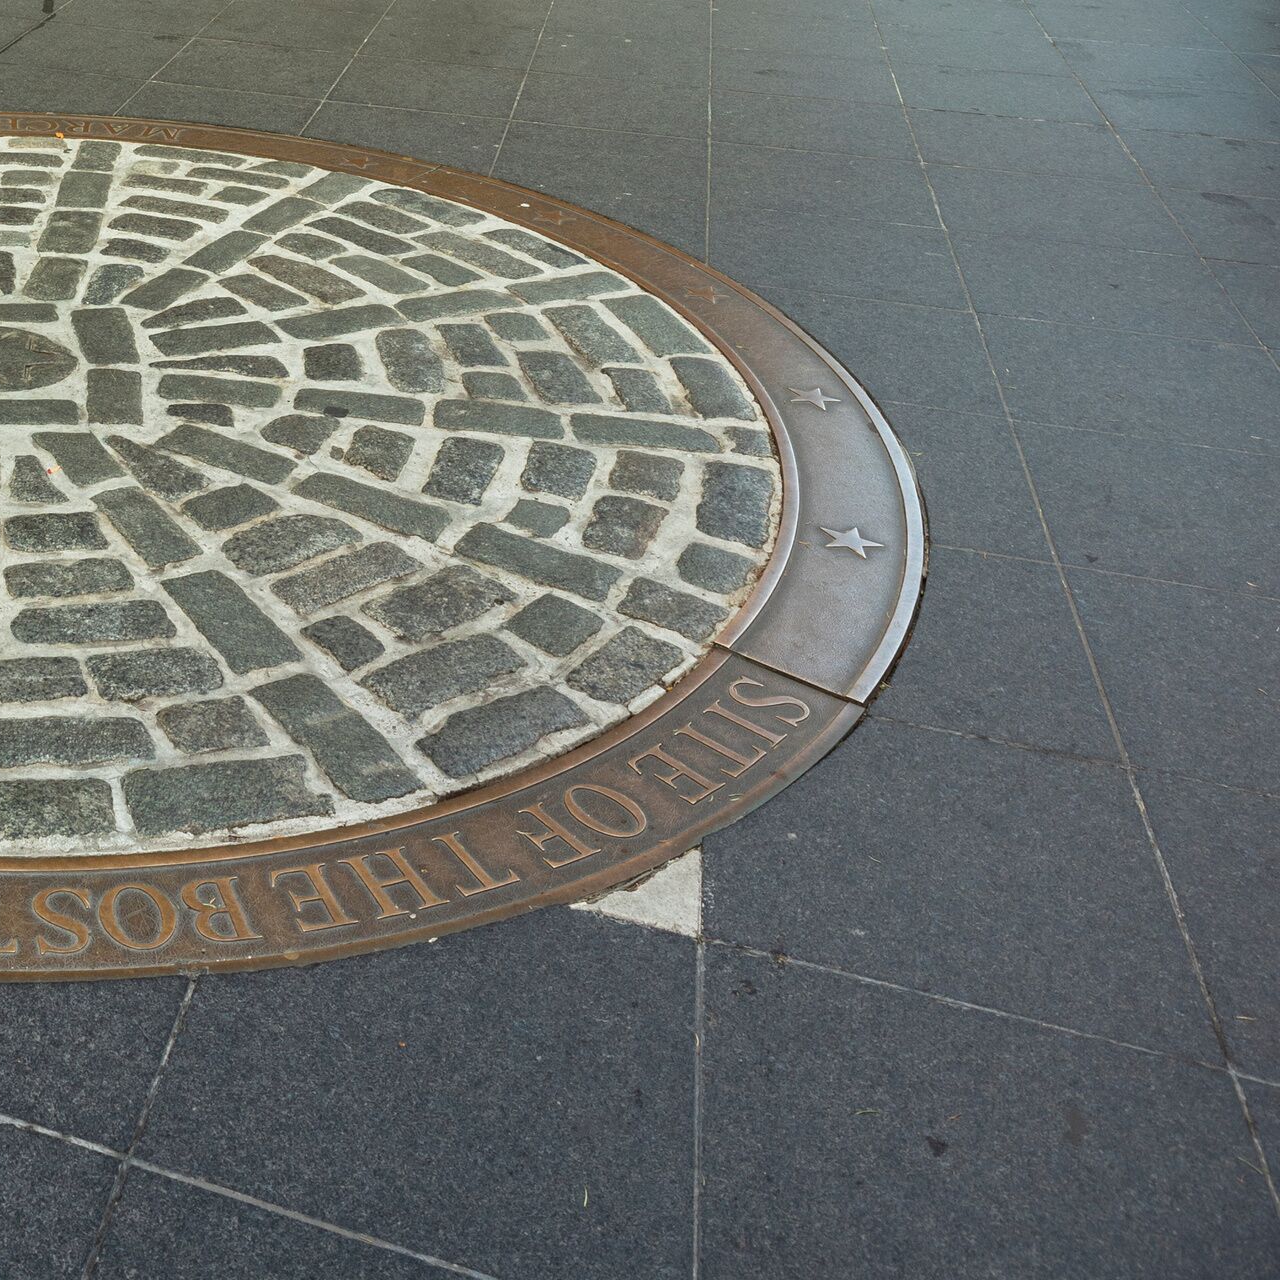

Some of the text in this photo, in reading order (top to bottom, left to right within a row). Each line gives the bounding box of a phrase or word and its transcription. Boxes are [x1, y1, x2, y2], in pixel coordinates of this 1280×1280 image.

[626, 675, 810, 805] SITE
[516, 783, 648, 869] OF
[270, 831, 521, 933] THE
